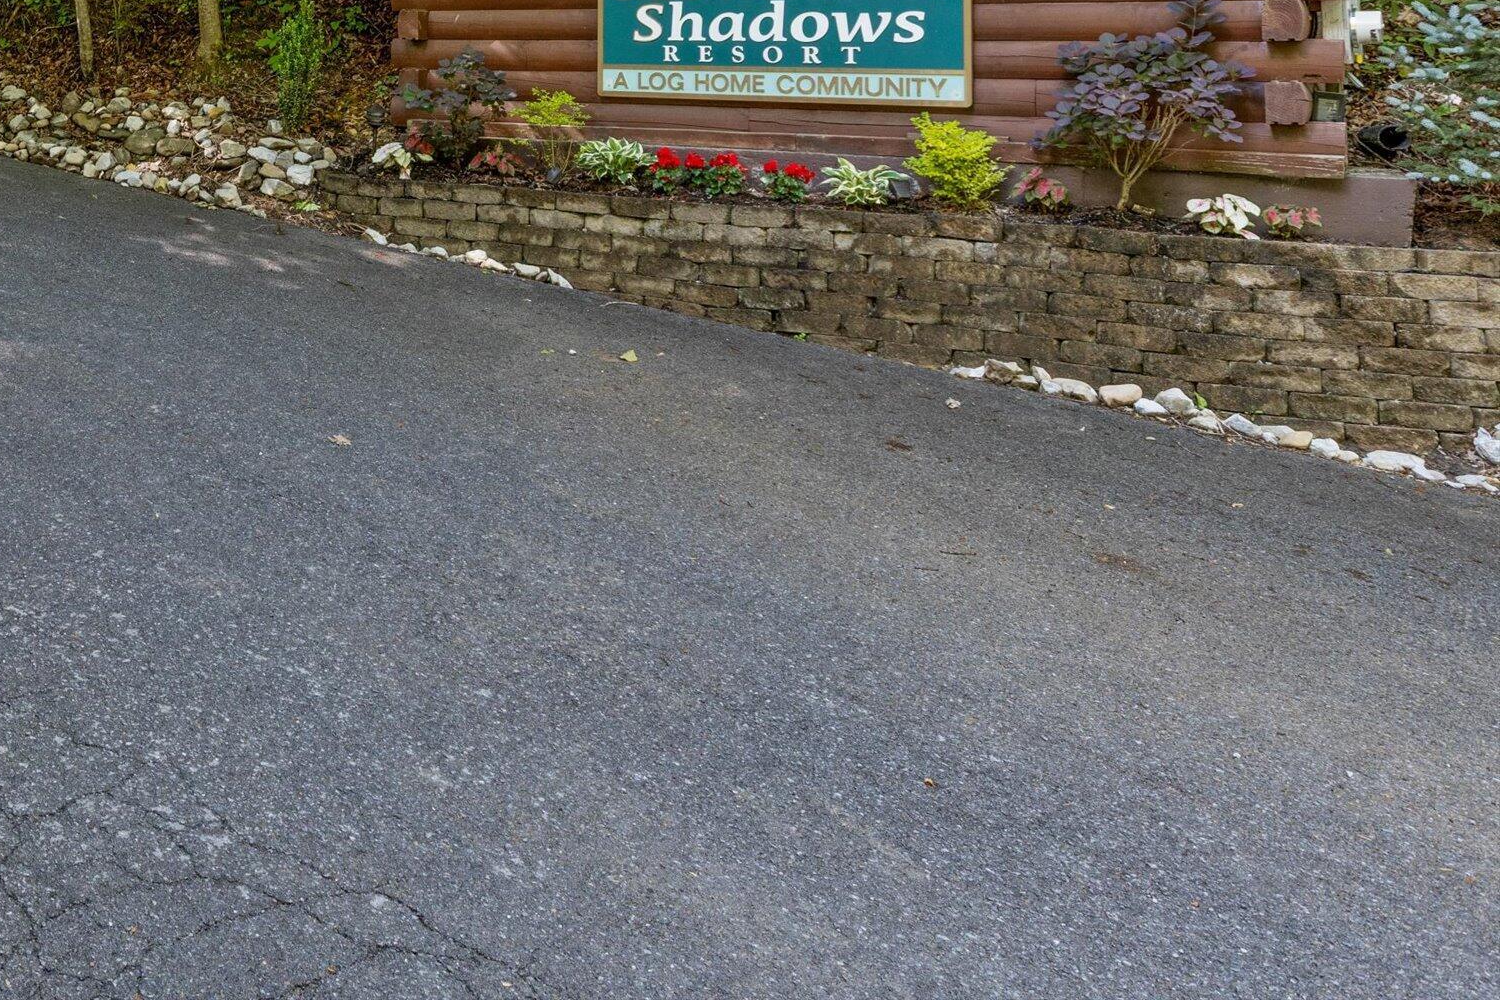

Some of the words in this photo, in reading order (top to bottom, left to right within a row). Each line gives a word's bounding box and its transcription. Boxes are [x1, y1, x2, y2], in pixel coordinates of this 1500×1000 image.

[633, 0, 926, 43] Shadows
[662, 45, 863, 64] RESORT
[612, 71, 629, 90] A
[637, 71, 685, 92] LOG
[695, 73, 765, 94] HOME
[776, 75, 948, 98] COMMUNITY
